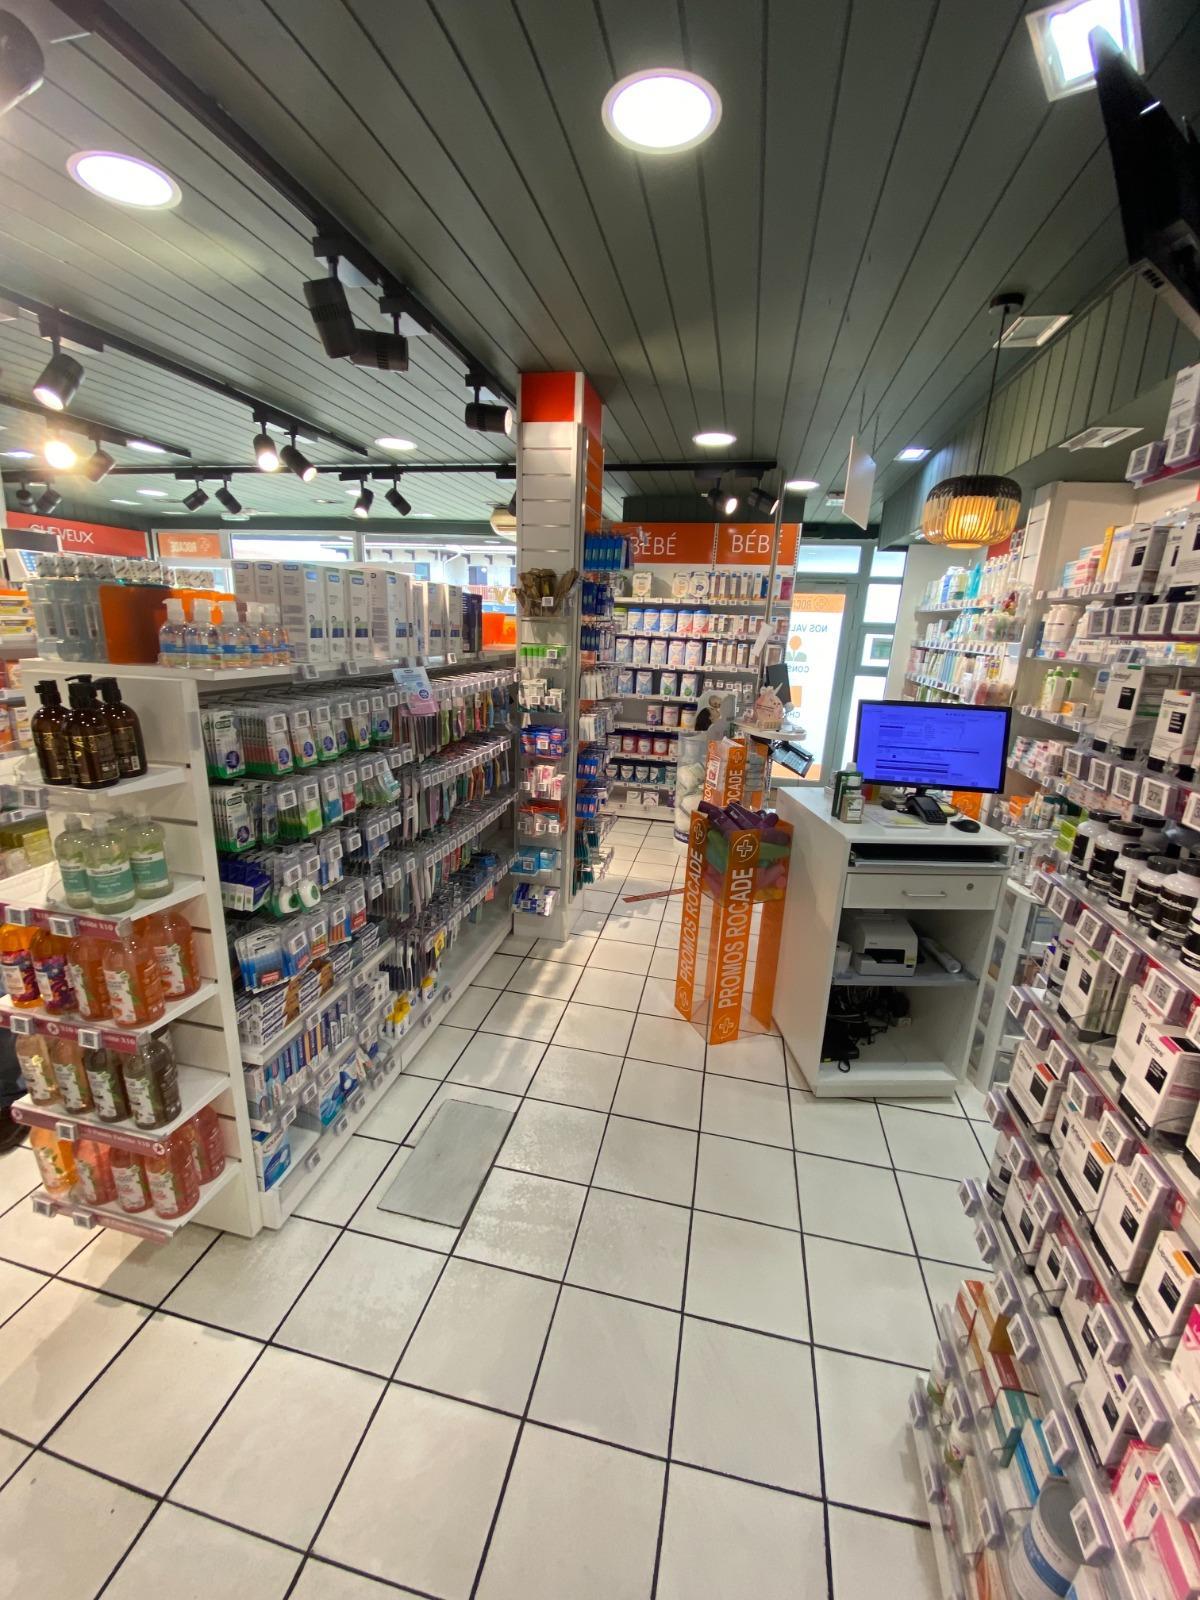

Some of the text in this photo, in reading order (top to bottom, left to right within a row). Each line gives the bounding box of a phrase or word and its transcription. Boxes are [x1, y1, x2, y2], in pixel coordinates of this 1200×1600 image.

[726, 769, 743, 805] OCADE
[680, 847, 703, 987] PROMOS ROCADE
[718, 867, 754, 1008] PROMOS ROCADE
